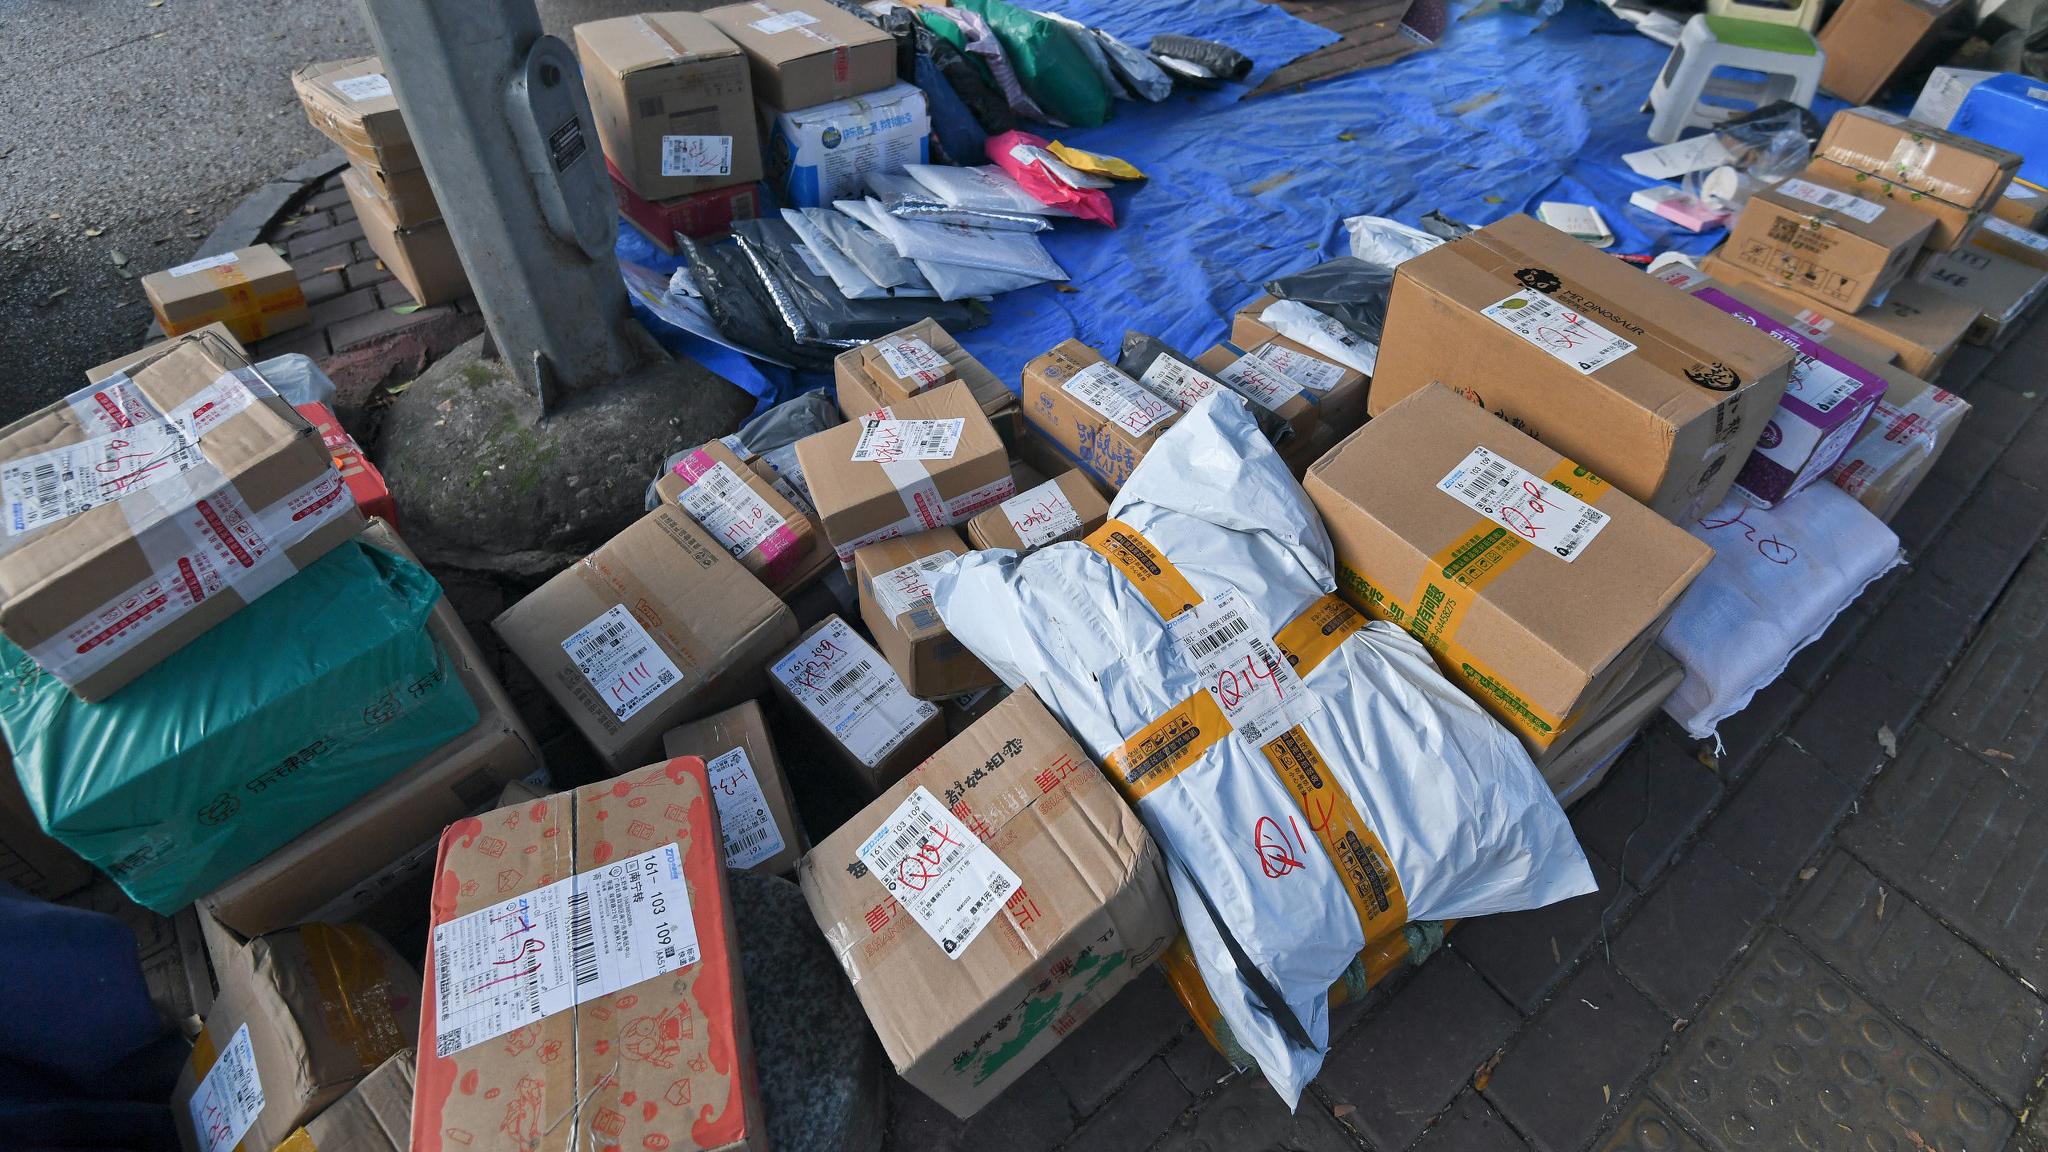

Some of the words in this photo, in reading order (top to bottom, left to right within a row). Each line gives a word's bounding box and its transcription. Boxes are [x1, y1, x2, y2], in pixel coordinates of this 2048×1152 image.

[1562, 288, 1584, 303] MR
[1469, 464, 1482, 476] 103
[1480, 455, 1492, 466] 109
[1196, 626, 1209, 637] 103
[786, 655, 810, 674] 161-
[1217, 653, 1285, 710] Q14
[1033, 753, 1080, 795] 善元
[868, 841, 889, 859] 161-
[890, 818, 908, 835] 103
[905, 804, 923, 820] 109
[1254, 792, 1337, 880] Q14
[625, 870, 647, 904] 南宁转
[648, 891, 666, 915] 103
[653, 921, 672, 946] 109
